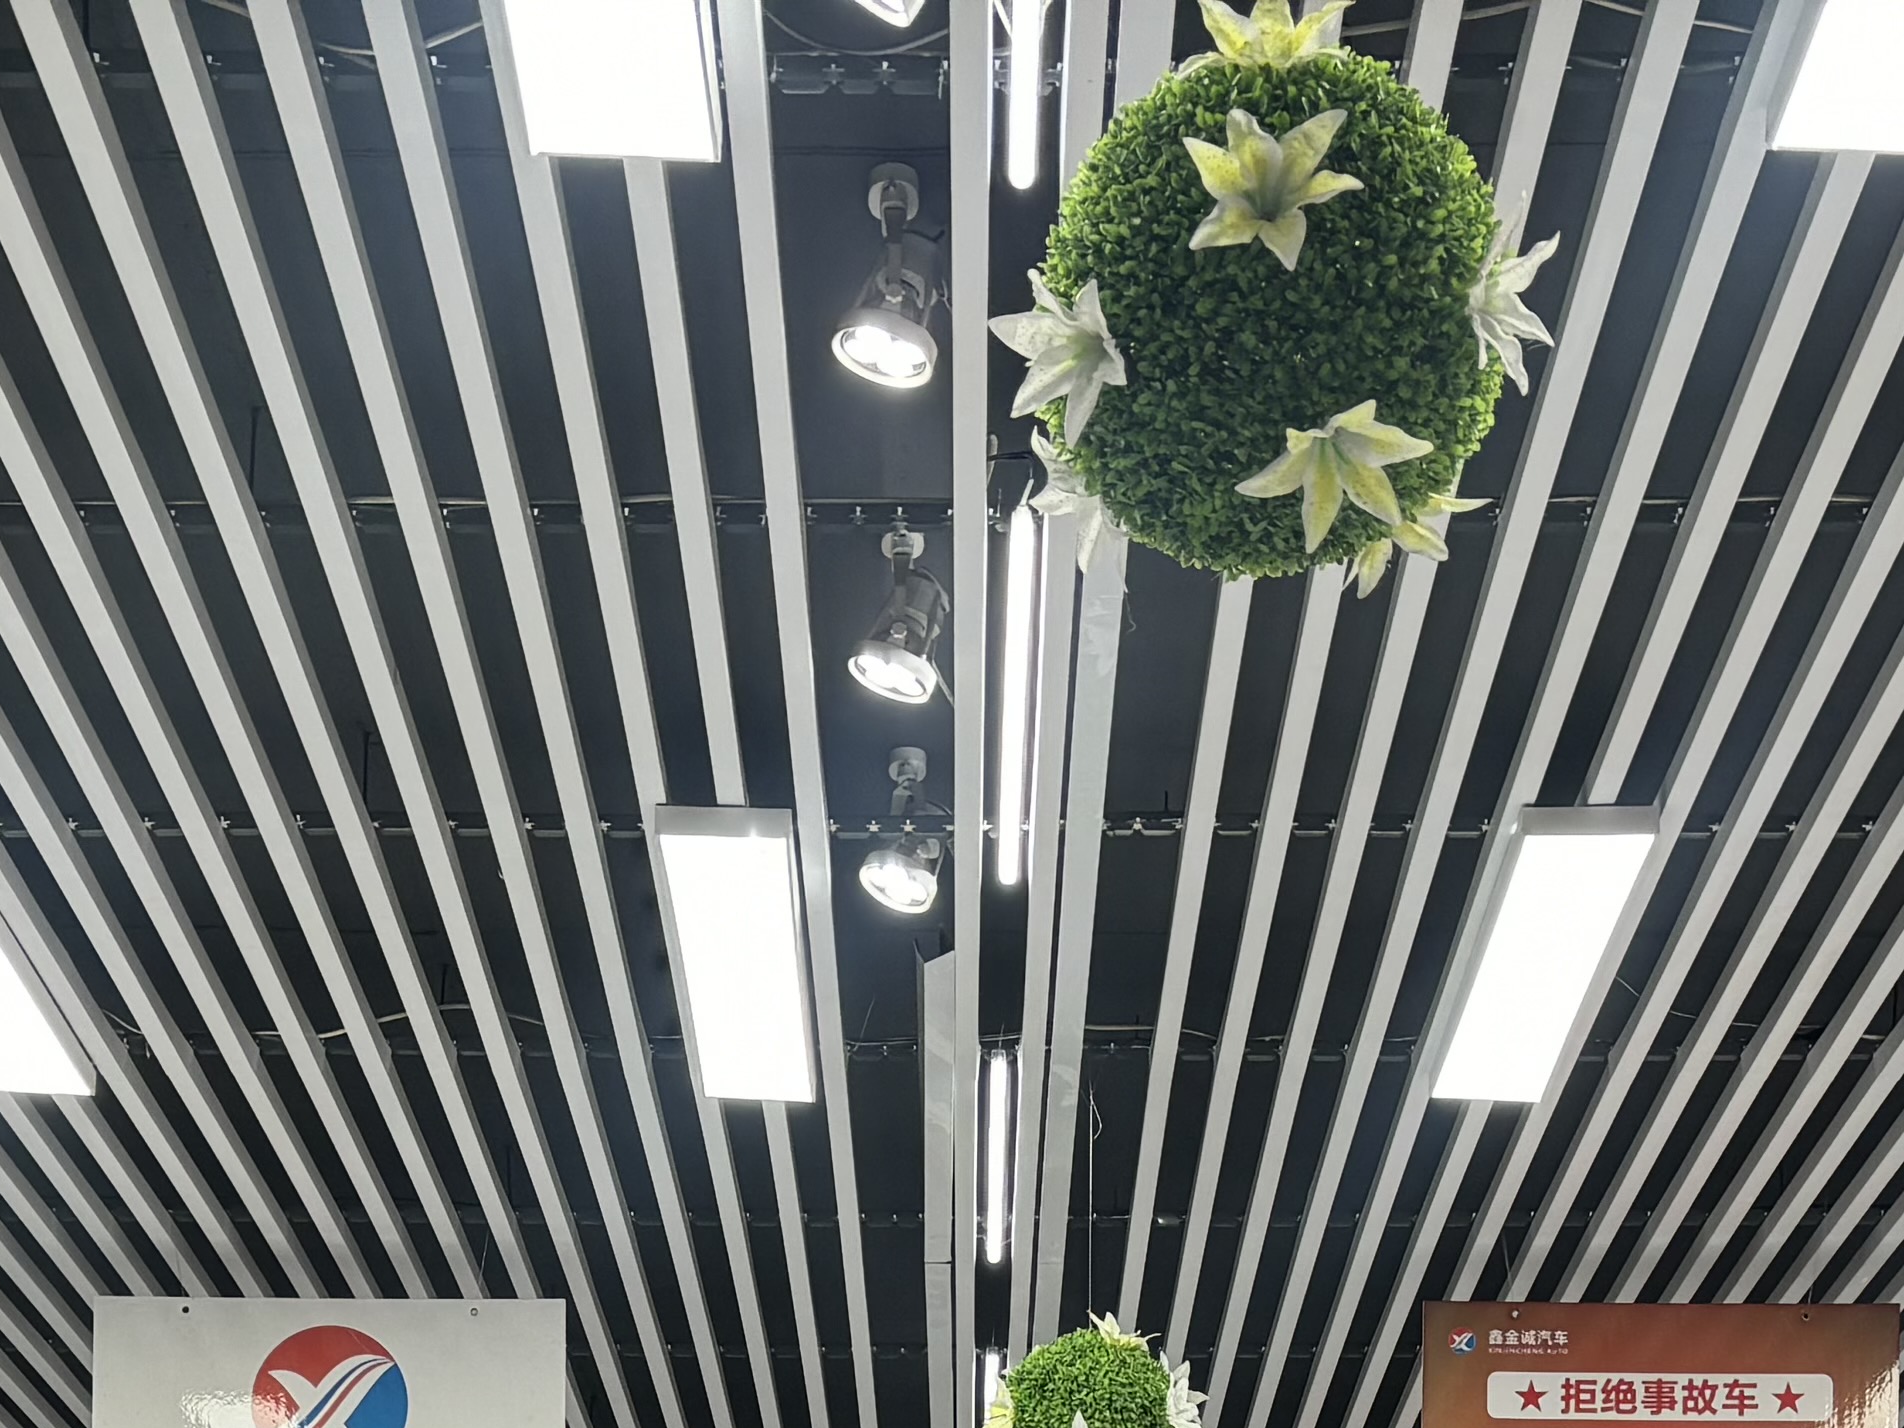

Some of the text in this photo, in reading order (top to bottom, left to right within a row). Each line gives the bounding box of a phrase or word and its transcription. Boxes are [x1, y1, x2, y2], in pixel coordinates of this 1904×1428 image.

[1488, 1330, 1569, 1346] 鑫金诚汽车
[1560, 1377, 1759, 1416] 拒绝事故车
